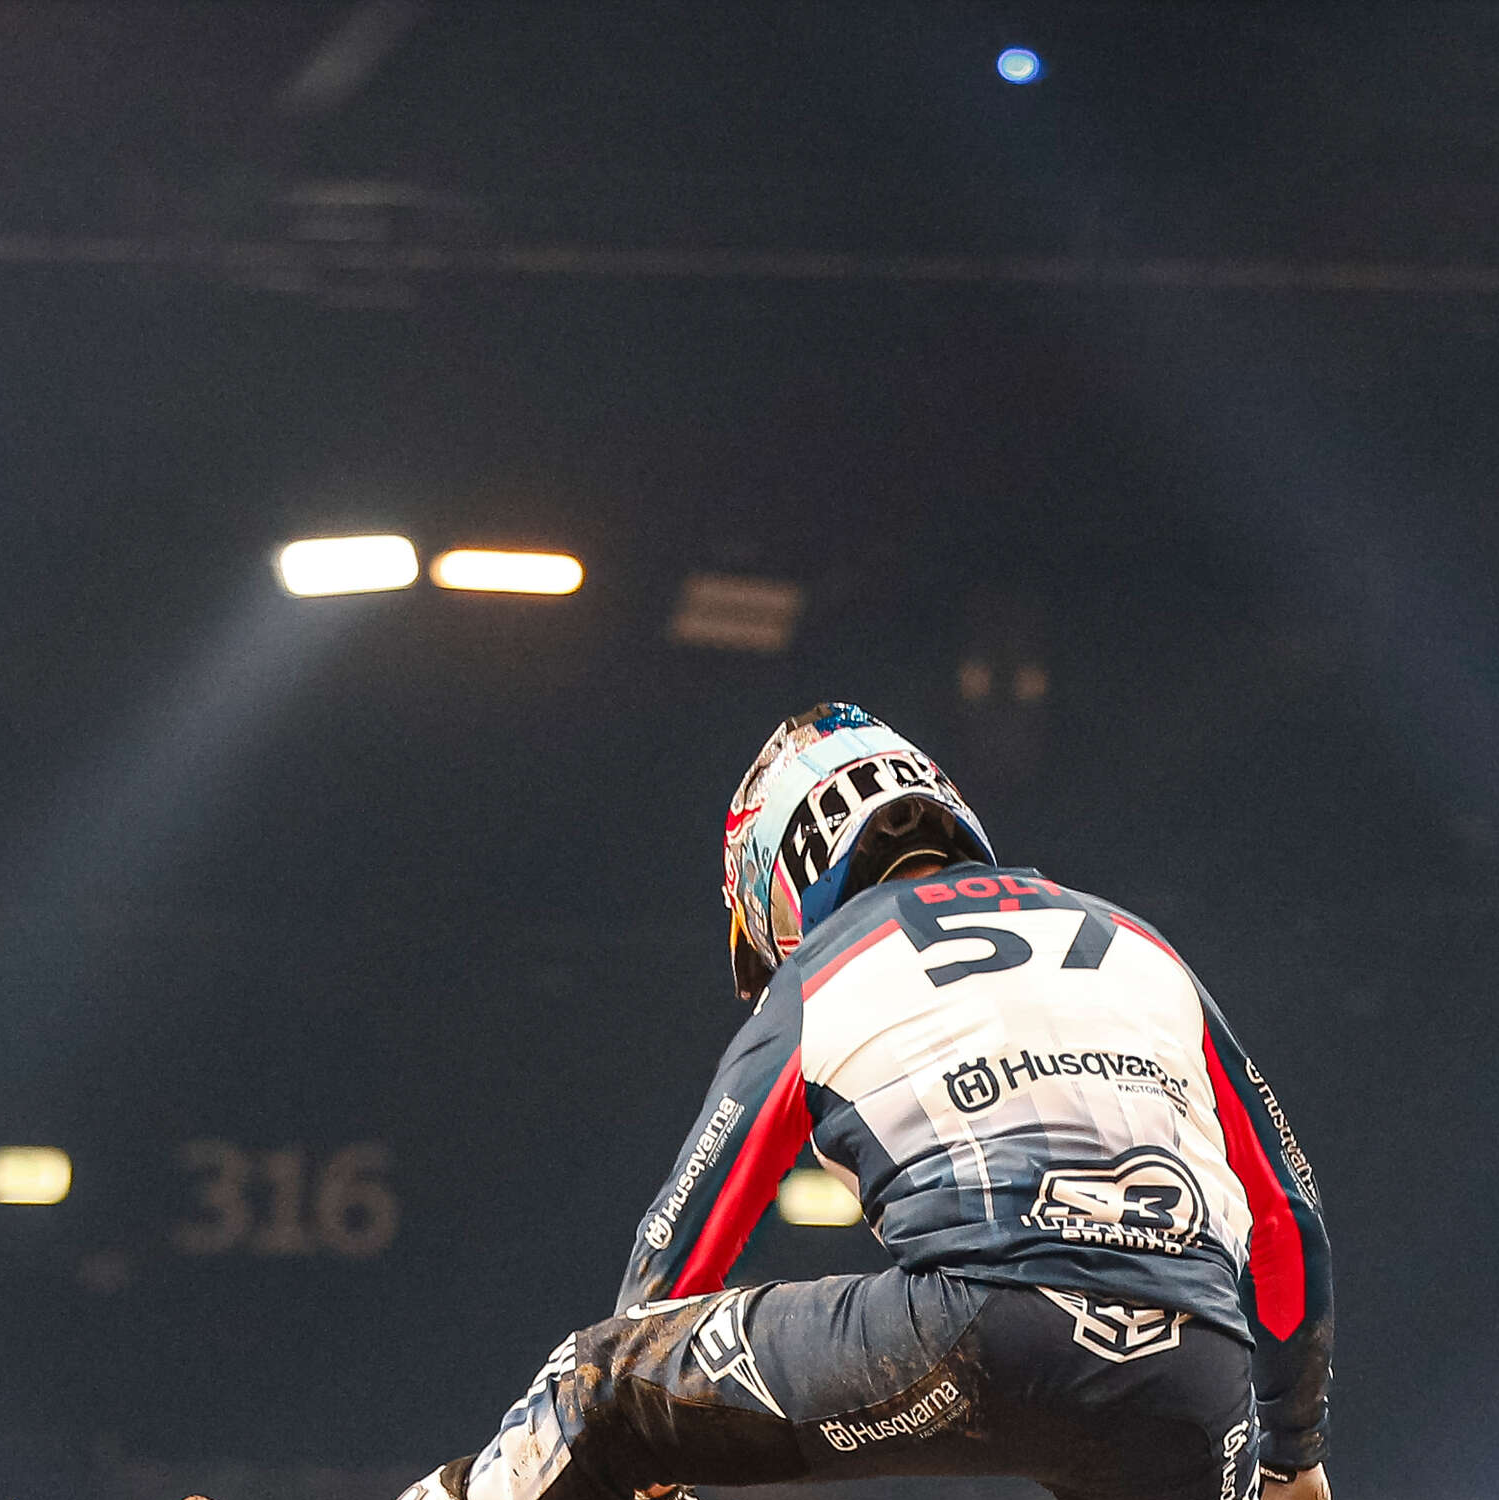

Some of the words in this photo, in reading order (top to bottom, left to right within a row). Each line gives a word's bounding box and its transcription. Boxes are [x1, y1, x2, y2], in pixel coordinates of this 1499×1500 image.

[913, 875, 1062, 904] BOLT
[898, 900, 1119, 987] 57
[173, 1138, 399, 1257] 316
[662, 1096, 737, 1222] Husqvarna
[849, 1380, 960, 1444] Husqvarna
